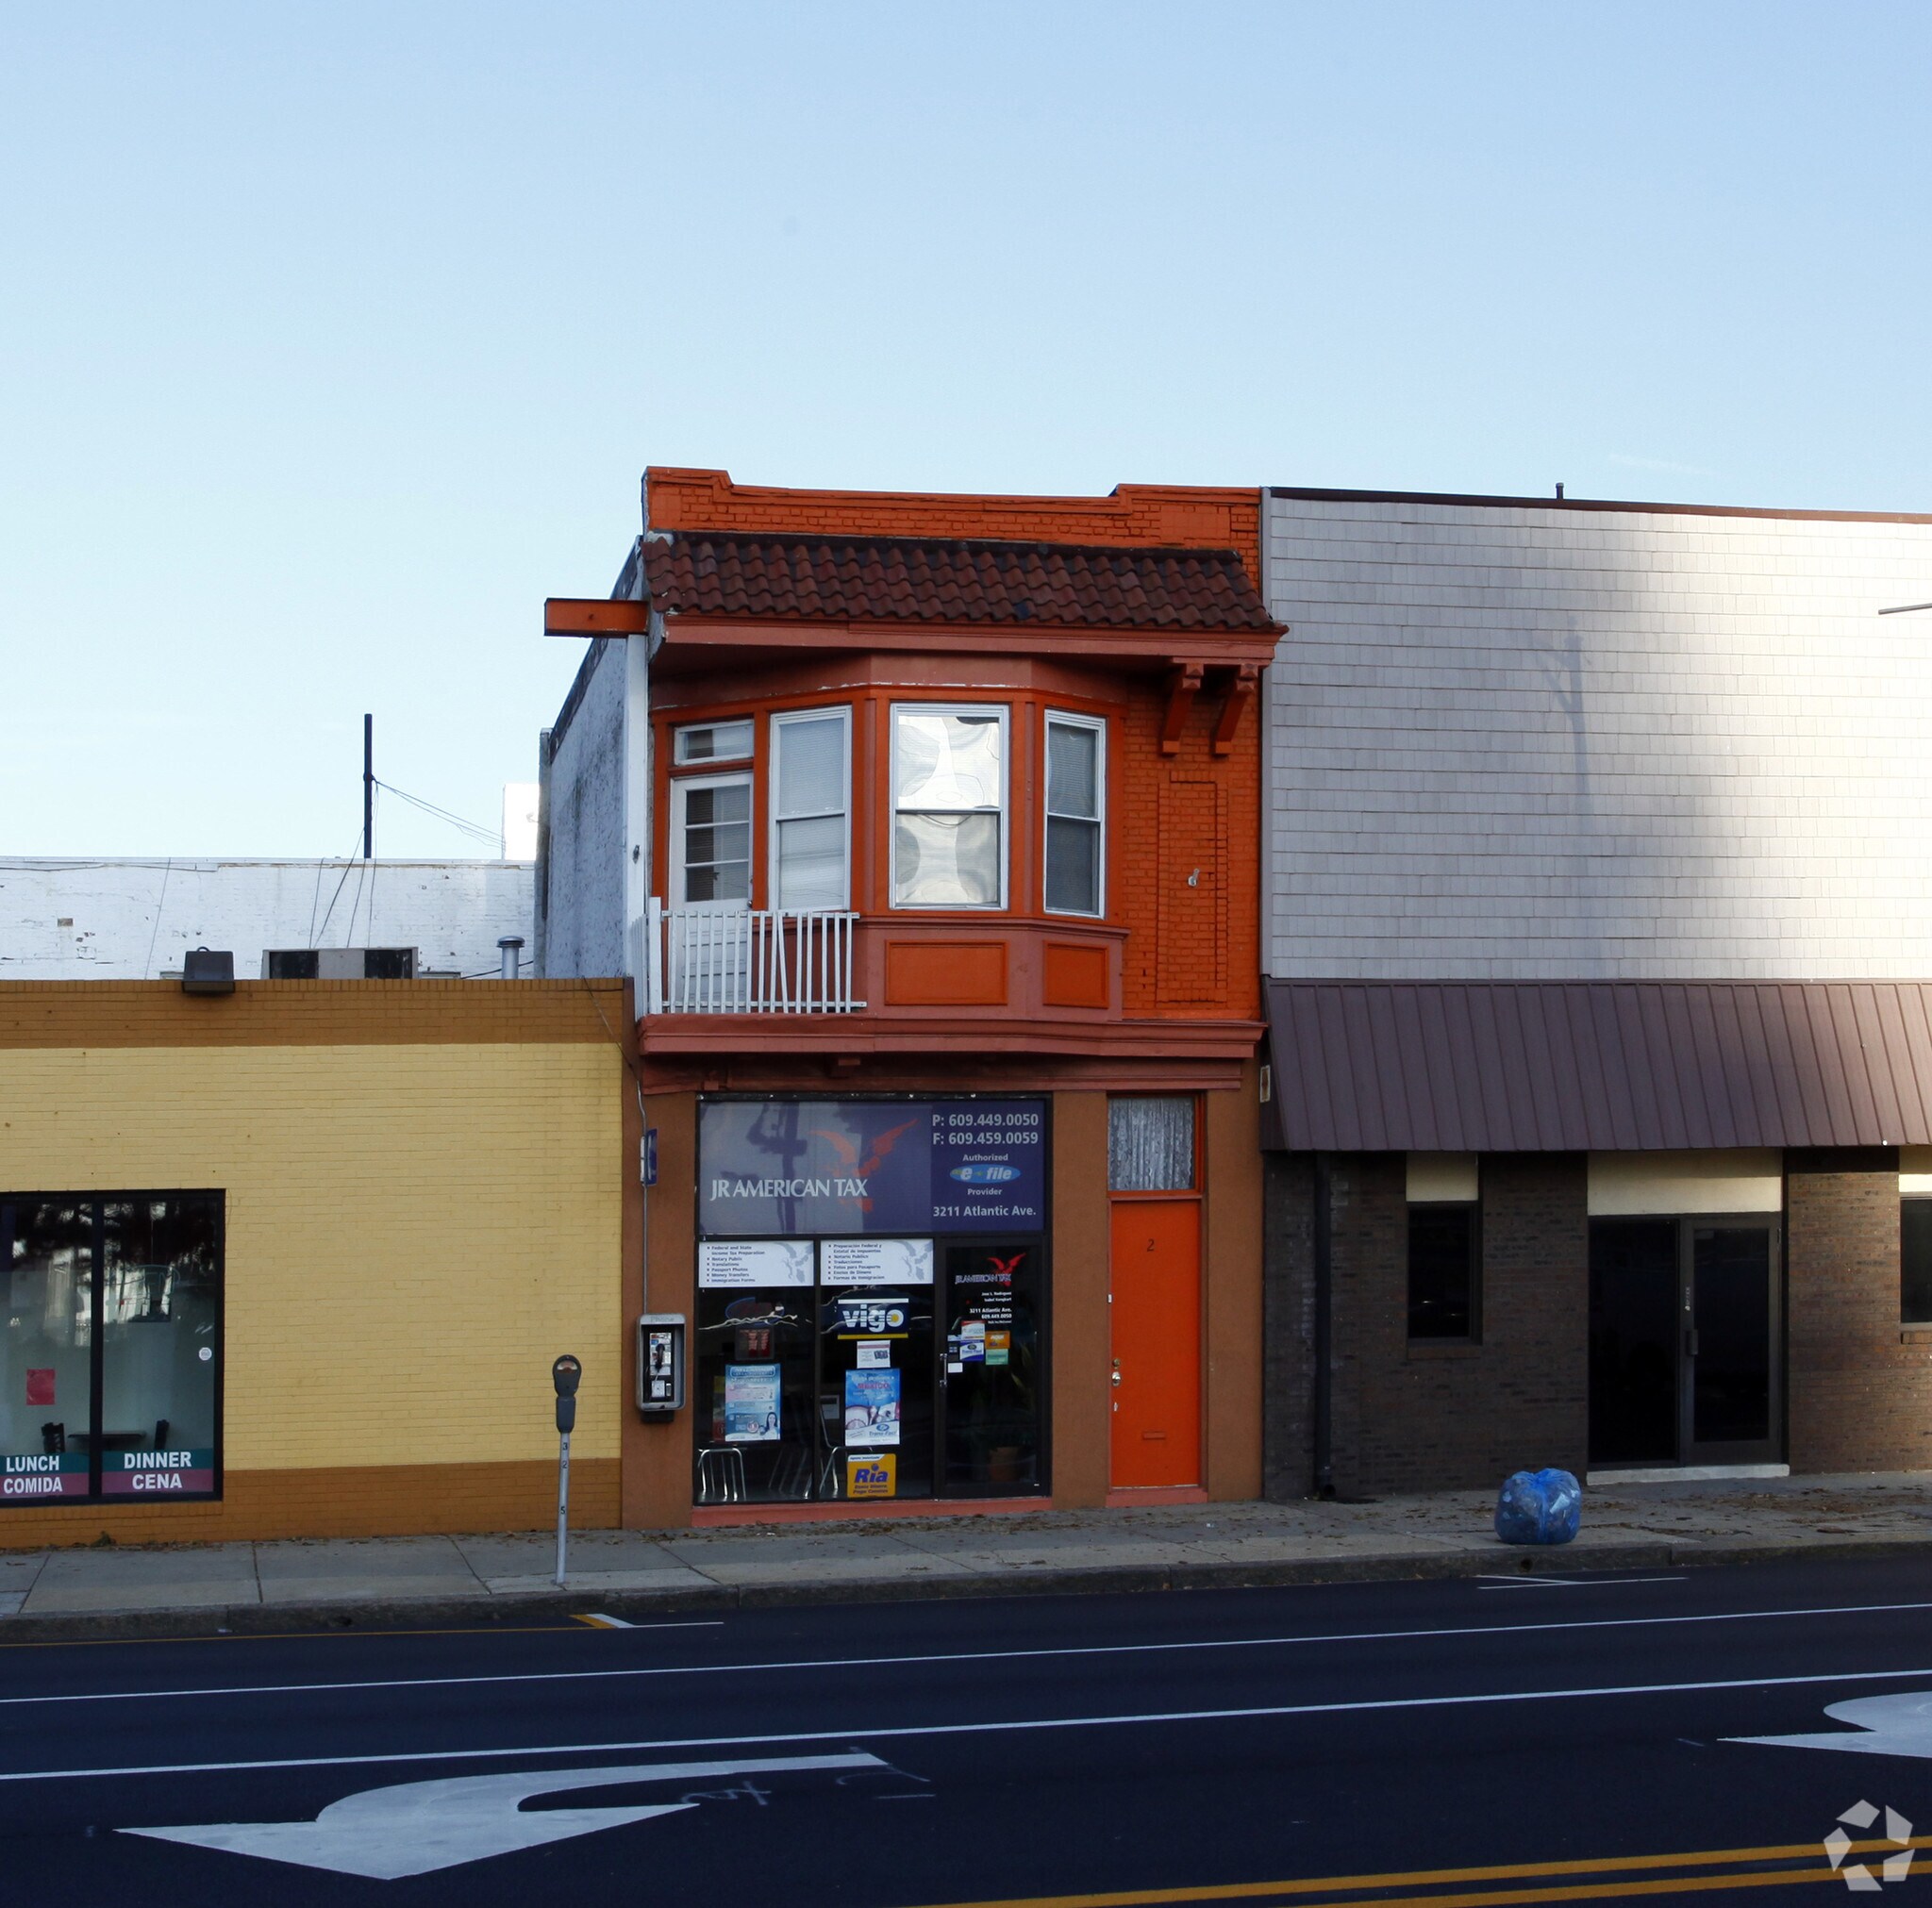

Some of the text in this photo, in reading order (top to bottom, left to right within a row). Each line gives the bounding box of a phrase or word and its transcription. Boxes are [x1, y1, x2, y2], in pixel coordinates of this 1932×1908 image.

[932, 1114, 1039, 1126] P: 609.449.0050
[932, 1132, 1039, 1145] F: 609.459.0059
[709, 1179, 868, 1201] JR AMERICAN TAX
[933, 1205, 1037, 1217] 3211 Atlantic Ave.
[1146, 1238, 1155, 1253] 2
[841, 1303, 905, 1333] vigo
[6, 1455, 59, 1472] LUNCH
[124, 1452, 192, 1469] DINNER
[132, 1473, 183, 1490] CENA
[854, 1463, 890, 1484] Ria
[4, 1477, 63, 1494] COMIDA
